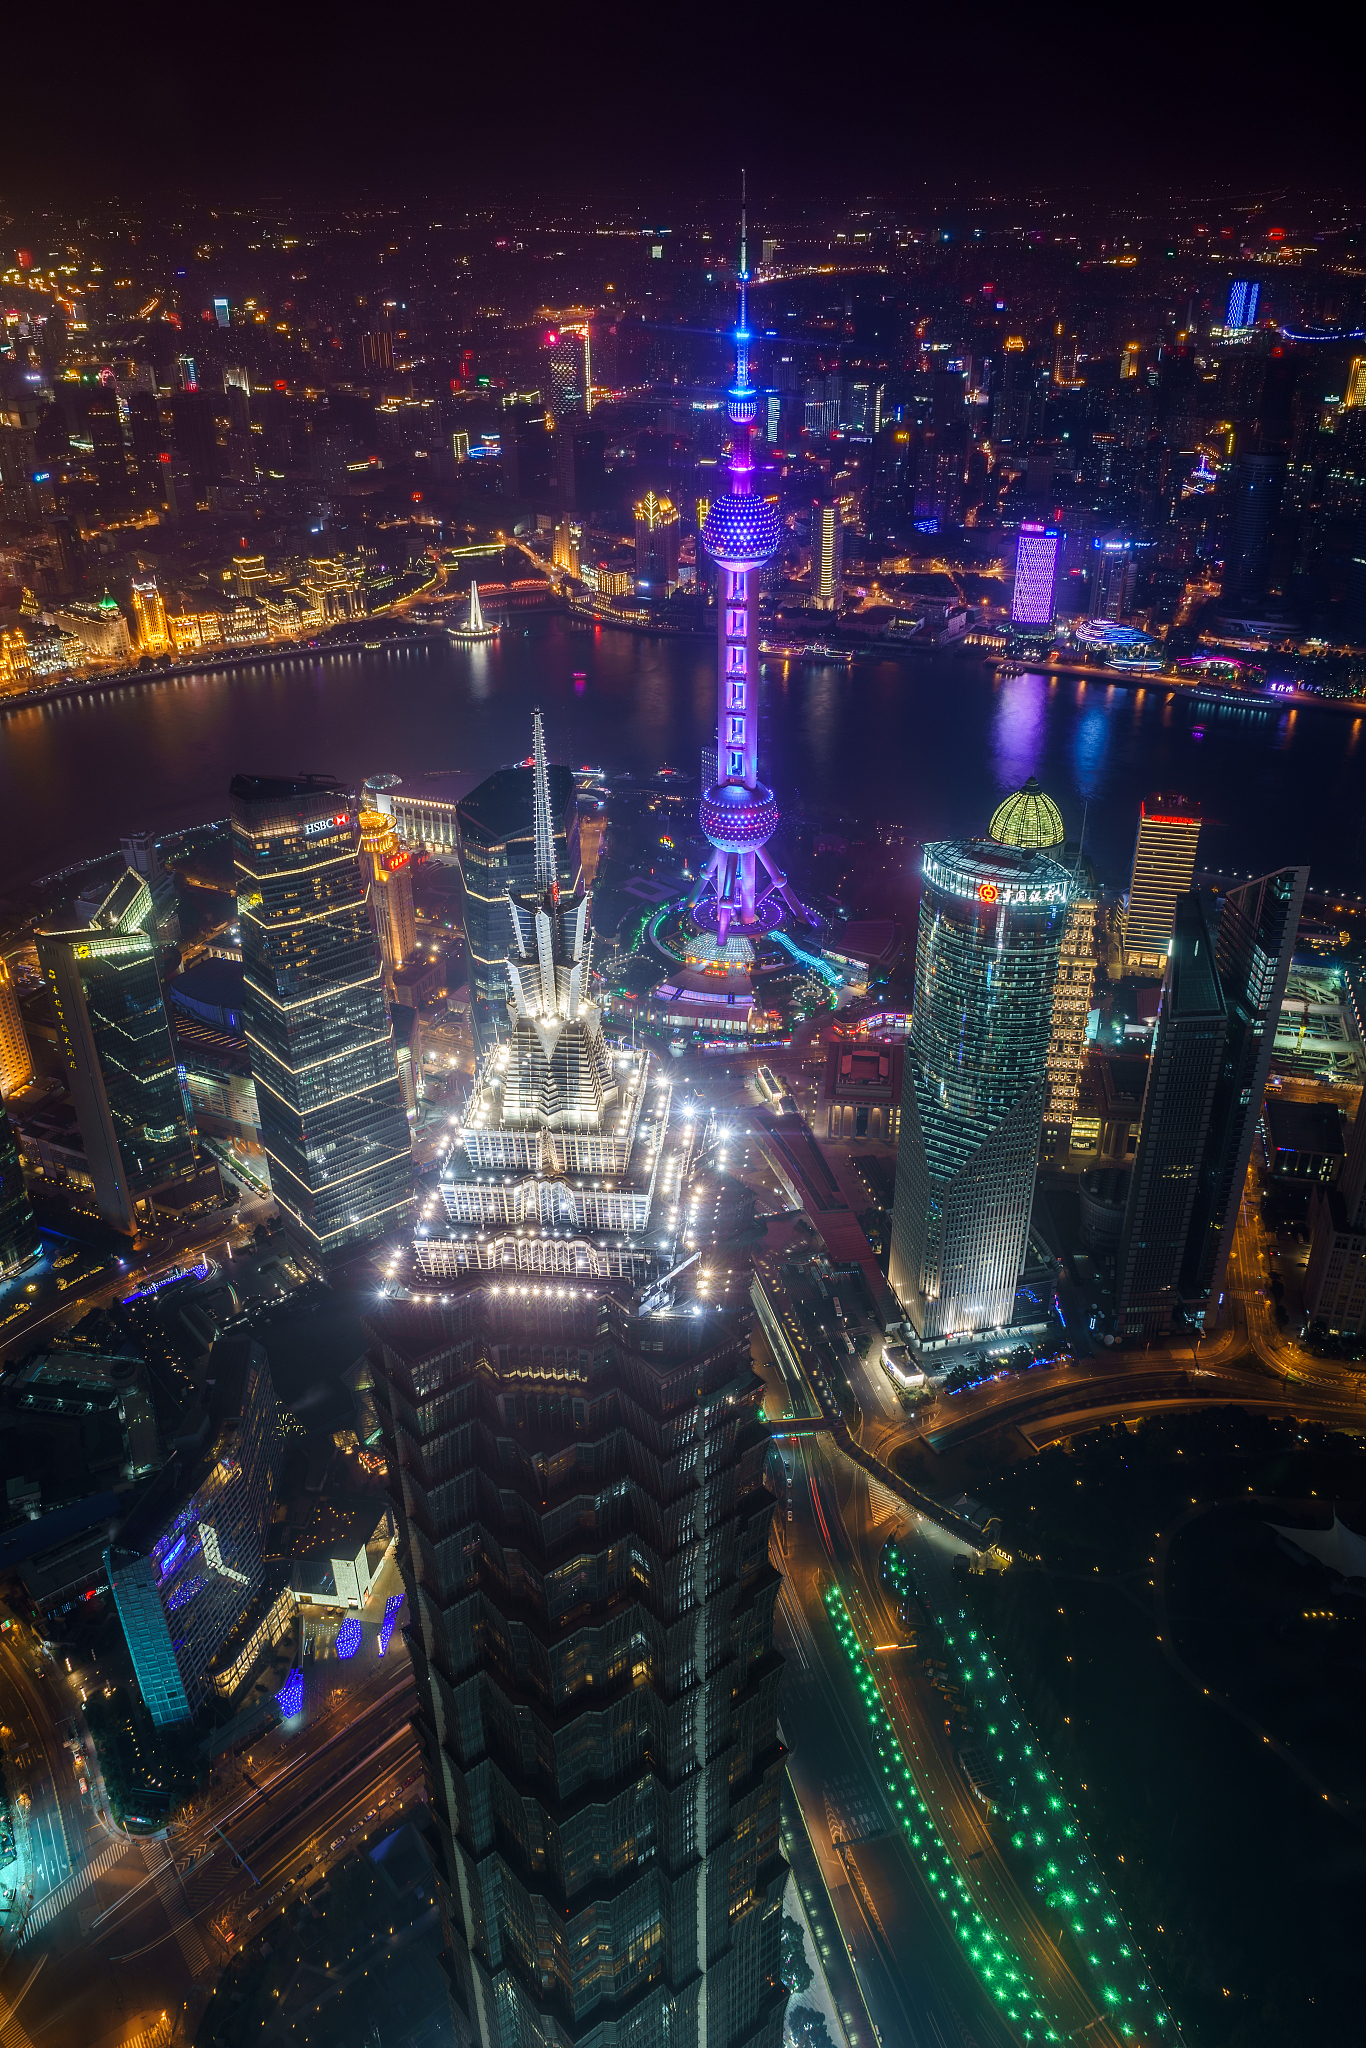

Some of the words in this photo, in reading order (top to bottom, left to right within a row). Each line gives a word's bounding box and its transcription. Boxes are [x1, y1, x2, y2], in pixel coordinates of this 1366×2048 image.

[305, 817, 335, 834] HSBC
[1002, 888, 1058, 902] 中国银行
